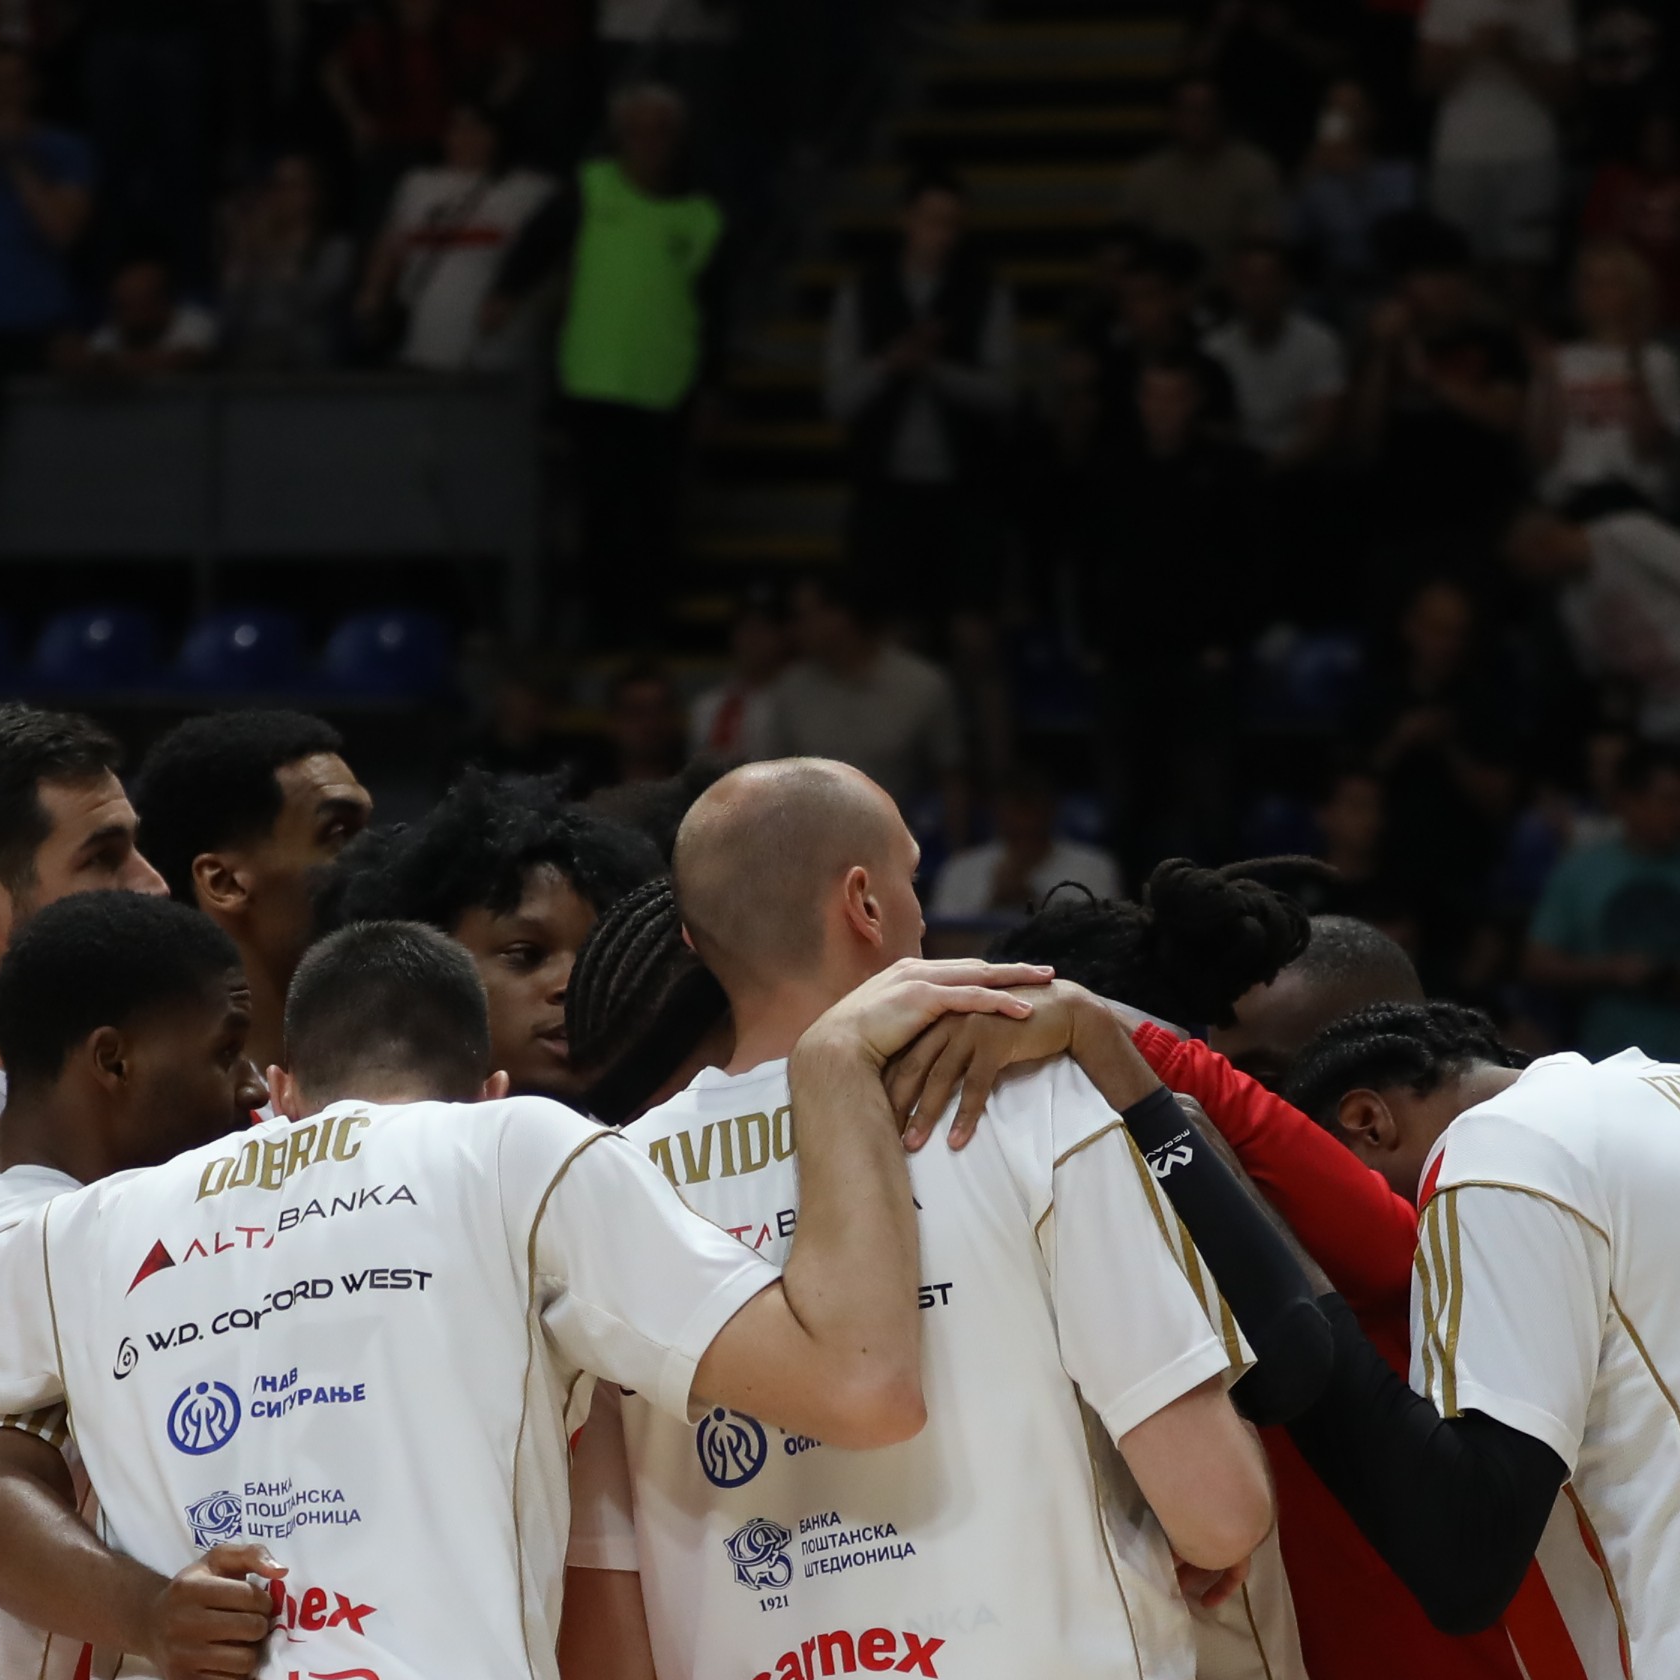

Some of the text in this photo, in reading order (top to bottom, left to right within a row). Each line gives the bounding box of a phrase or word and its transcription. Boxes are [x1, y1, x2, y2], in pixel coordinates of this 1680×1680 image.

[195, 1108, 371, 1204] DOBRIĆ
[649, 1104, 797, 1187] AVIDO
[146, 1322, 204, 1352] W.D.
[340, 1268, 433, 1294] WEST
[250, 1383, 366, 1418] СИГУРАЊЕ
[799, 1511, 842, 1535] БАНКА
[801, 1523, 898, 1556] ПОШТАНСКА
[804, 1542, 917, 1578] ШТЕДИОНИЦА
[758, 1595, 790, 1613] 1921
